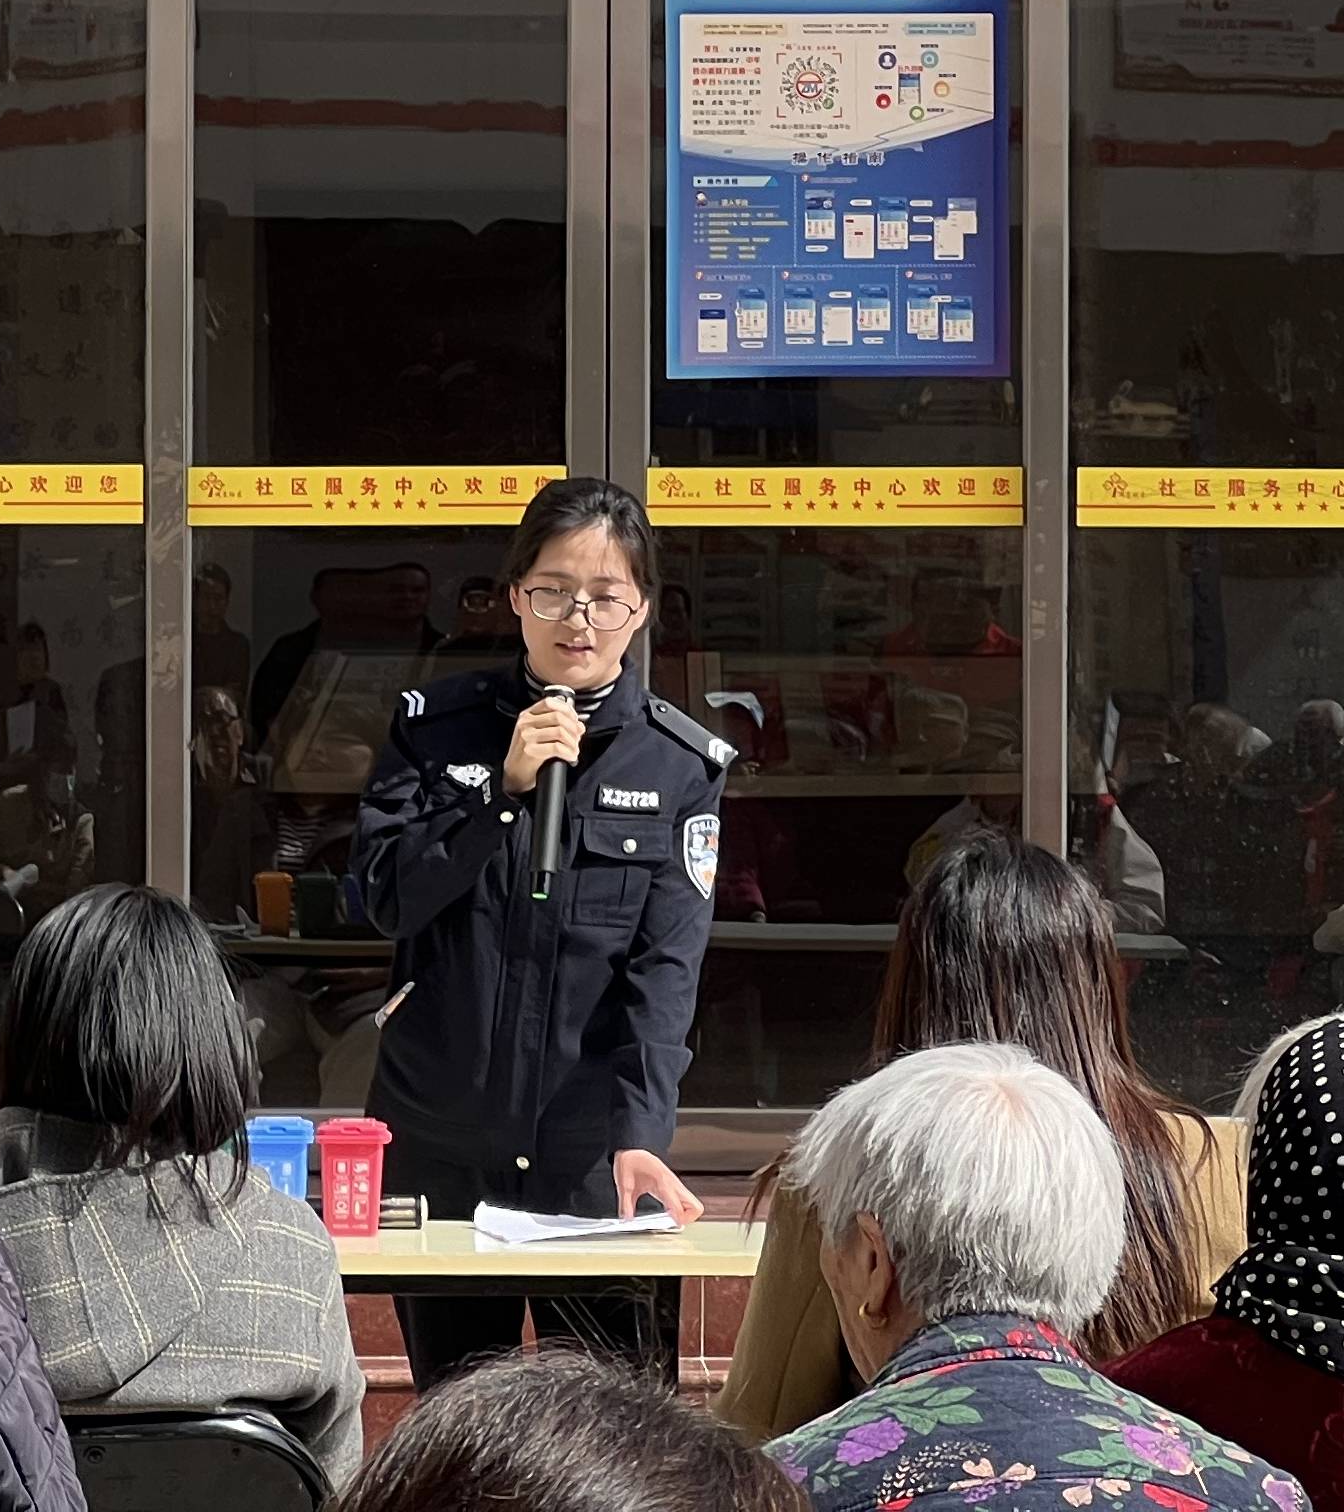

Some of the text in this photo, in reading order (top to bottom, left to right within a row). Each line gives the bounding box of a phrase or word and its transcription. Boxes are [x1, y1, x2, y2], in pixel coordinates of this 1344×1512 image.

[714, 476, 1011, 498] 社区服务中心欢迎您
